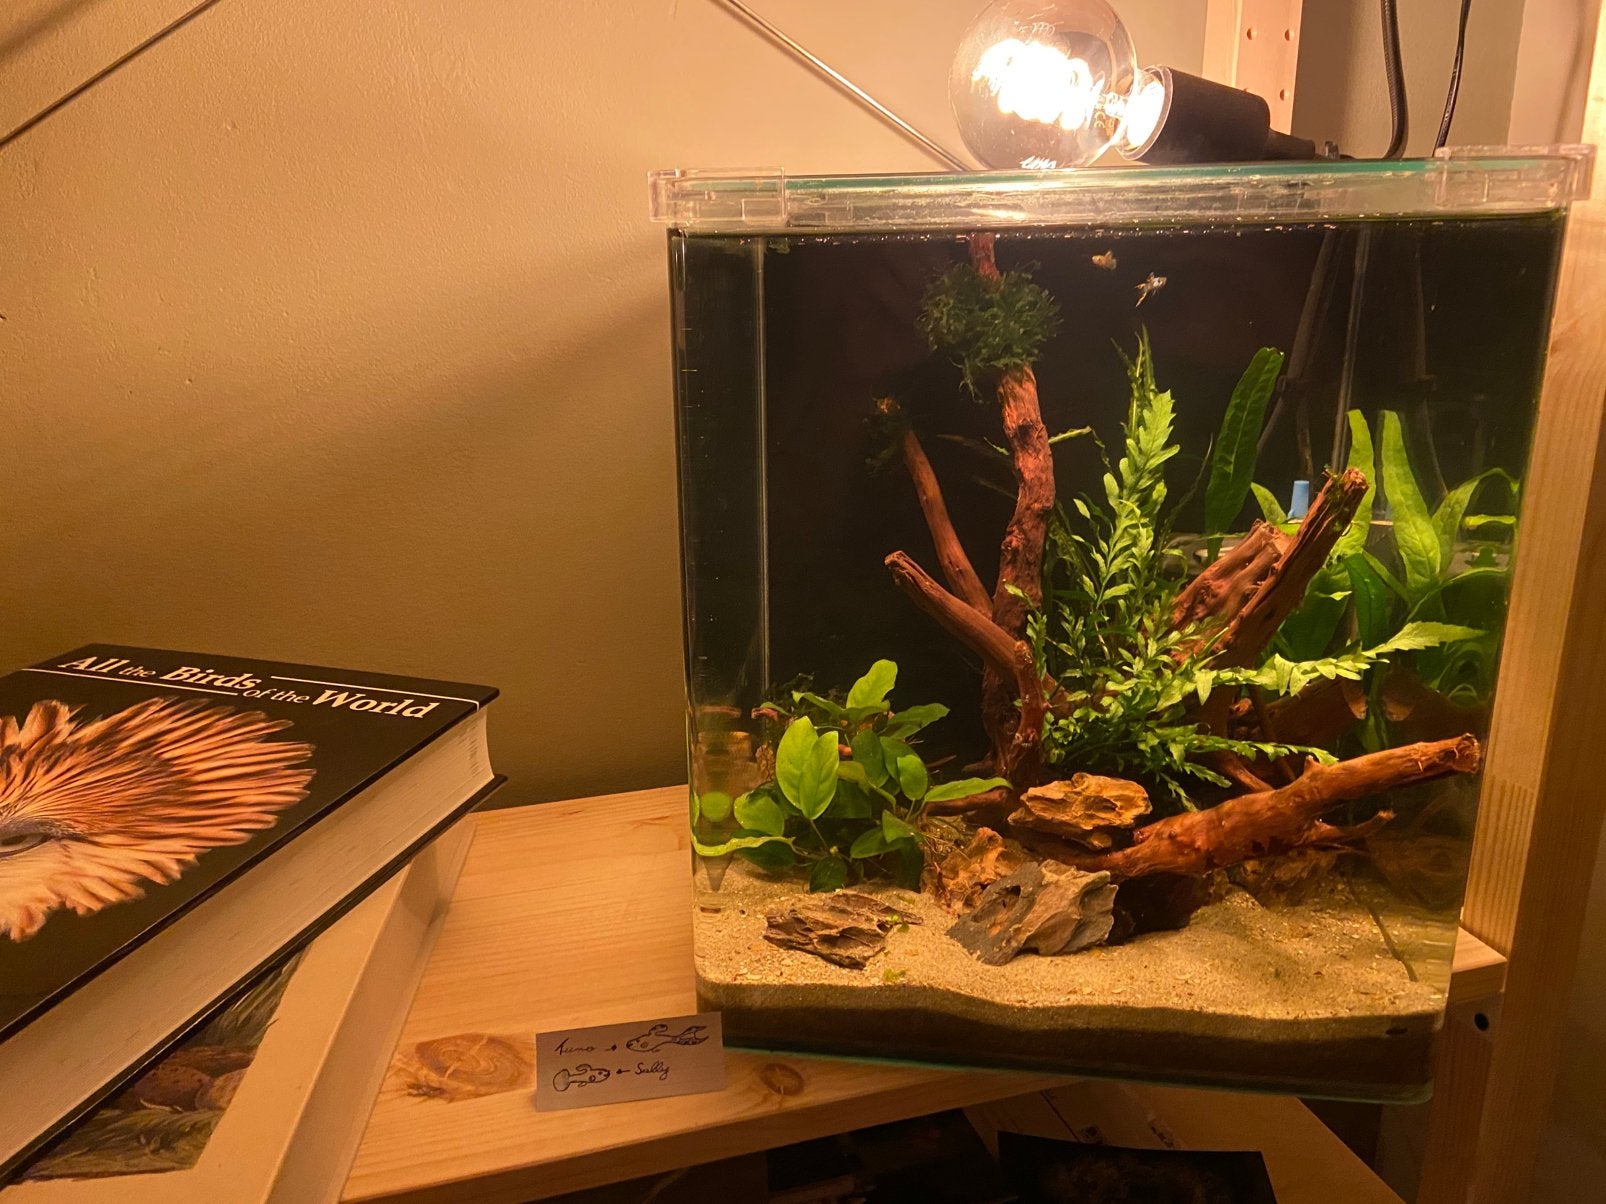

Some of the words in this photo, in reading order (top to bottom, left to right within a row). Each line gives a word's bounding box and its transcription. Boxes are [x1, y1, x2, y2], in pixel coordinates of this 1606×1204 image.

[57, 656, 130, 673] All
[118, 666, 156, 678] the
[159, 666, 262, 689] Birds
[242, 687, 276, 700] of
[271, 691, 310, 704] the
[312, 689, 440, 718] World
[634, 1061, 670, 1081] Sally
